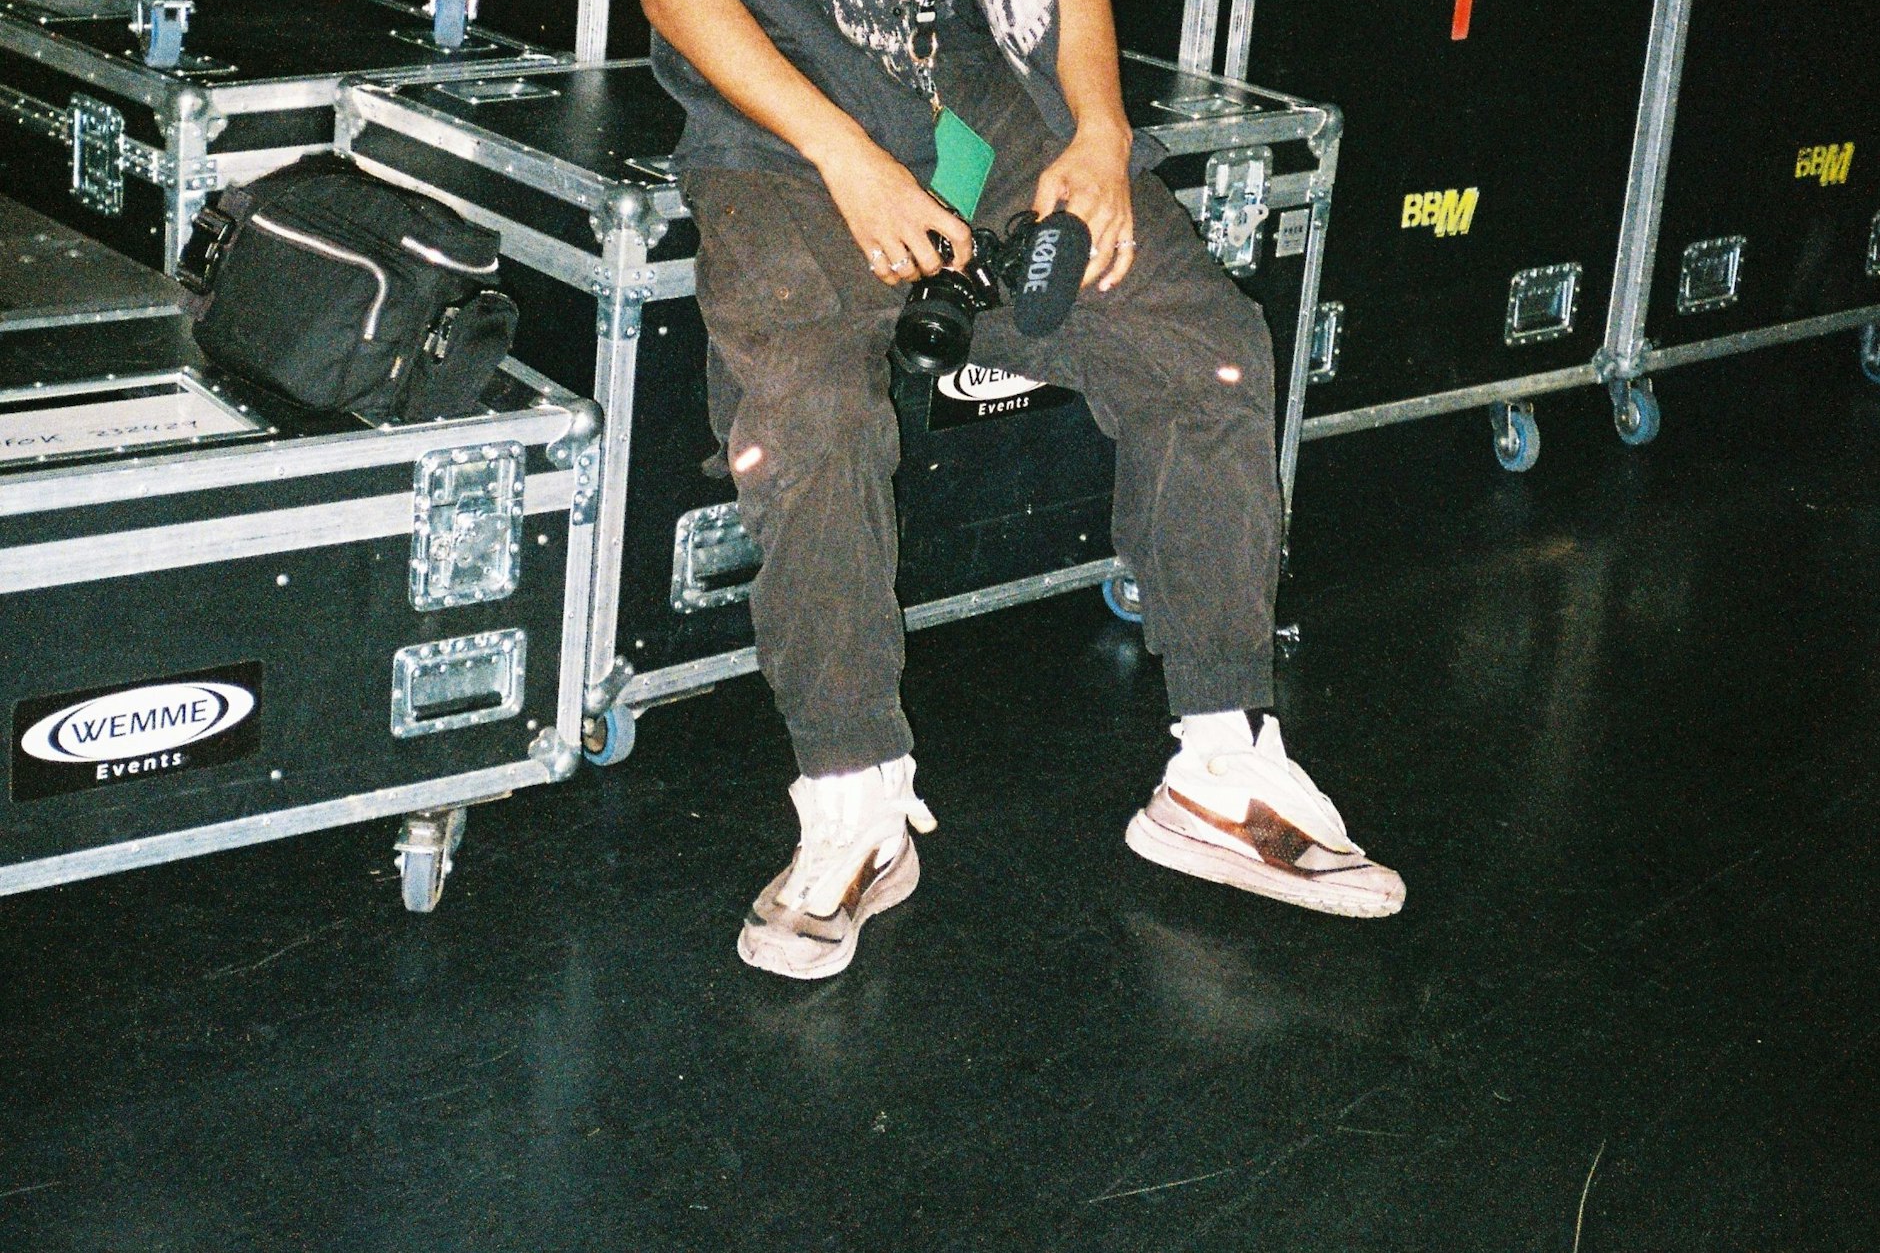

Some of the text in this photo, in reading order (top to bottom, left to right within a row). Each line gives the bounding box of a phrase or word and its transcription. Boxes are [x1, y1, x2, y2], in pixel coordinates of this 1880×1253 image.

[1400, 187, 1480, 237] BBM
[1022, 229, 1061, 294] RØDE
[978, 396, 1030, 416] Events
[71, 699, 208, 744] WEMME
[96, 751, 182, 780] Events
